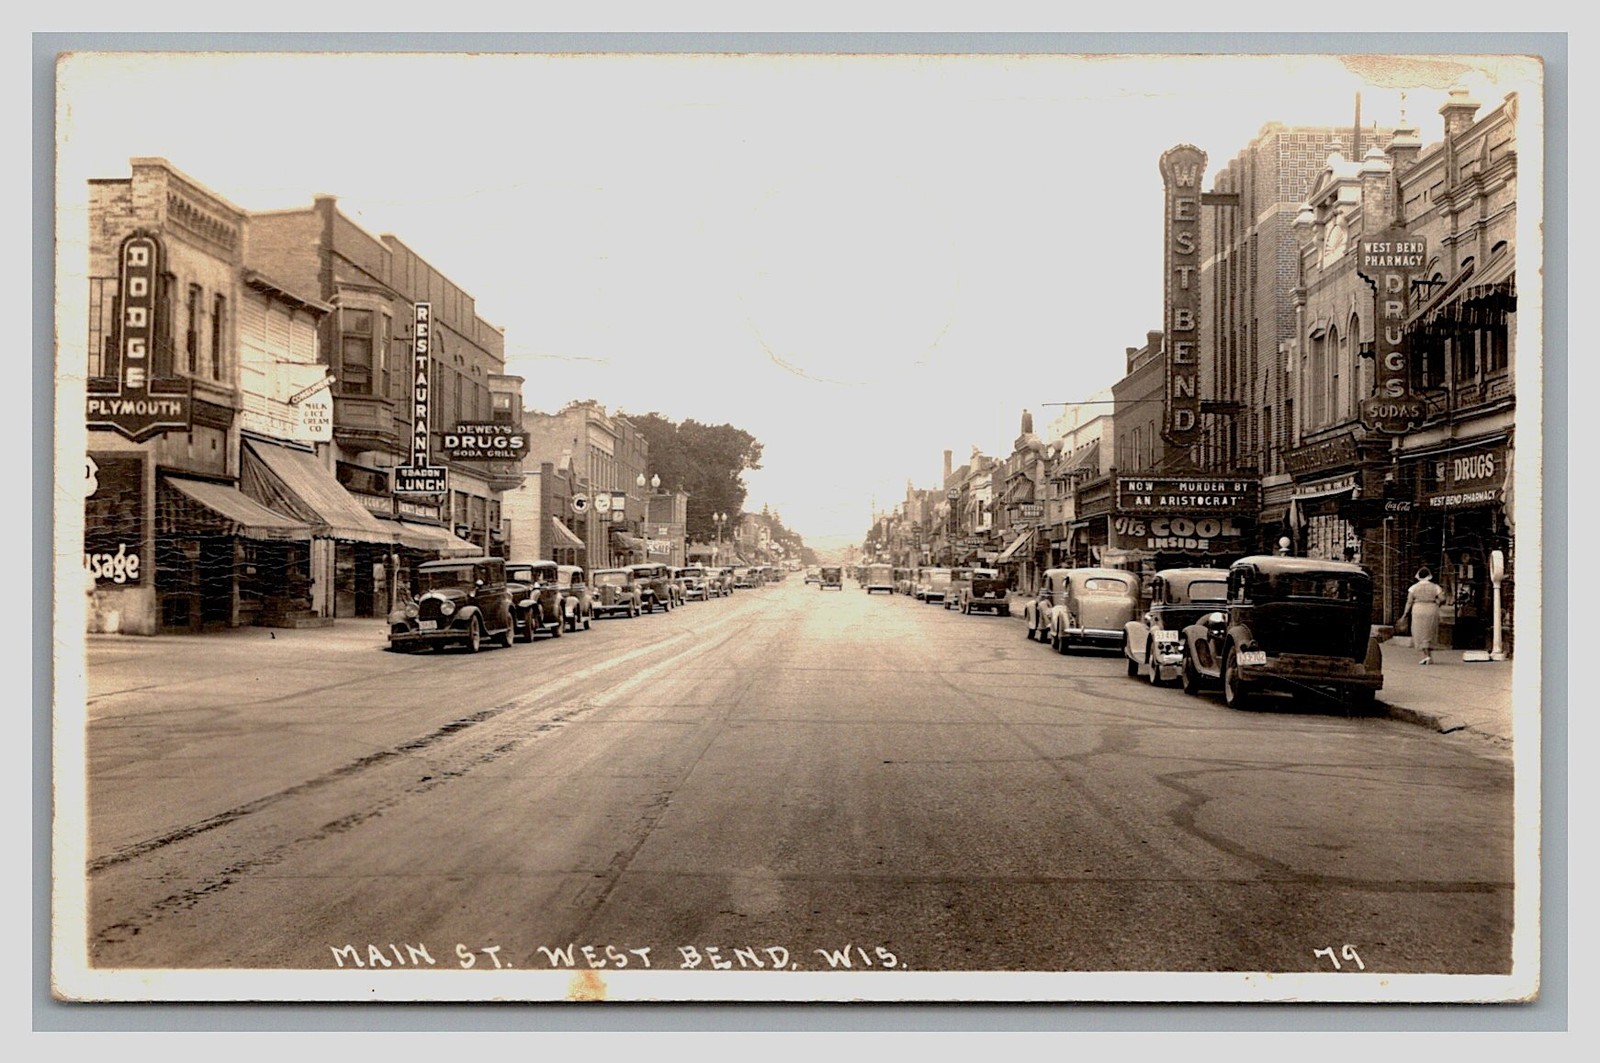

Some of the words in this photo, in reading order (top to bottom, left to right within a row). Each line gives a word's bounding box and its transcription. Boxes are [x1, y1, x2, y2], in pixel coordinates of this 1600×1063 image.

[1173, 163, 1198, 290] WEST
[1363, 242, 1391, 253] WEST
[1396, 242, 1424, 253] BEND
[1364, 256, 1423, 266] PHARMACY
[126, 247, 149, 388] DODGE
[1385, 275, 1405, 398] DRUGS
[1173, 308, 1196, 432] BEND
[415, 307, 428, 467] RESTAURANT
[88, 400, 181, 415] PLYMOUTH
[1369, 404, 1420, 418] SODAS
[457, 425, 512, 434] DEWEY'S
[444, 435, 524, 449] DRUGS
[1454, 453, 1494, 481] DRUGS
[396, 479, 445, 490] LUNCH
[1128, 481, 1154, 491] NOW
[1234, 482, 1248, 492] BY
[1135, 496, 1151, 505] AN
[1430, 496, 1445, 507] WEST
[1445, 494, 1462, 505] BEND
[1462, 489, 1497, 503] PHARMACY
[1151, 517, 1241, 538] COOL
[1147, 538, 1209, 550] INSIDE
